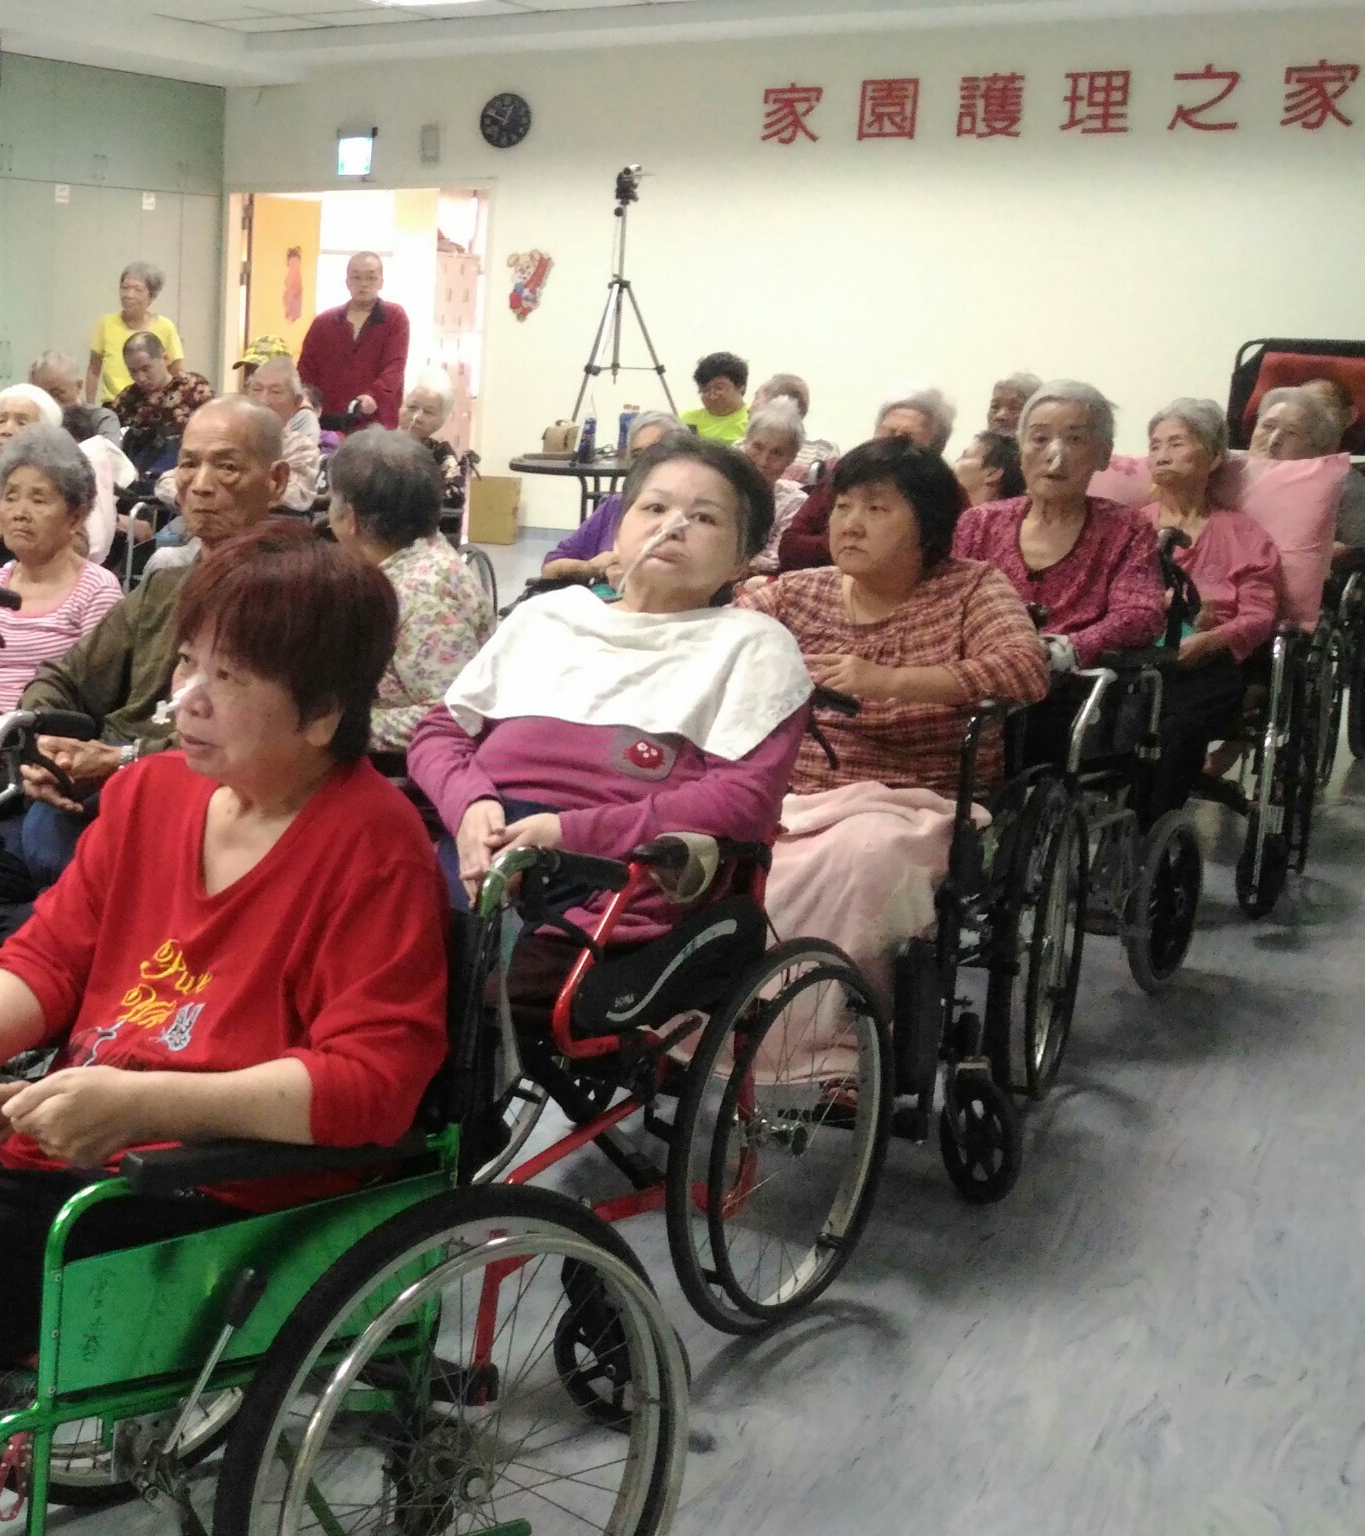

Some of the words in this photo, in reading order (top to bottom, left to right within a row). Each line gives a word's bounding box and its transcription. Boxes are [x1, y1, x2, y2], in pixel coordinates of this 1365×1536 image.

[761, 58, 1360, 145] 家園護理之家
